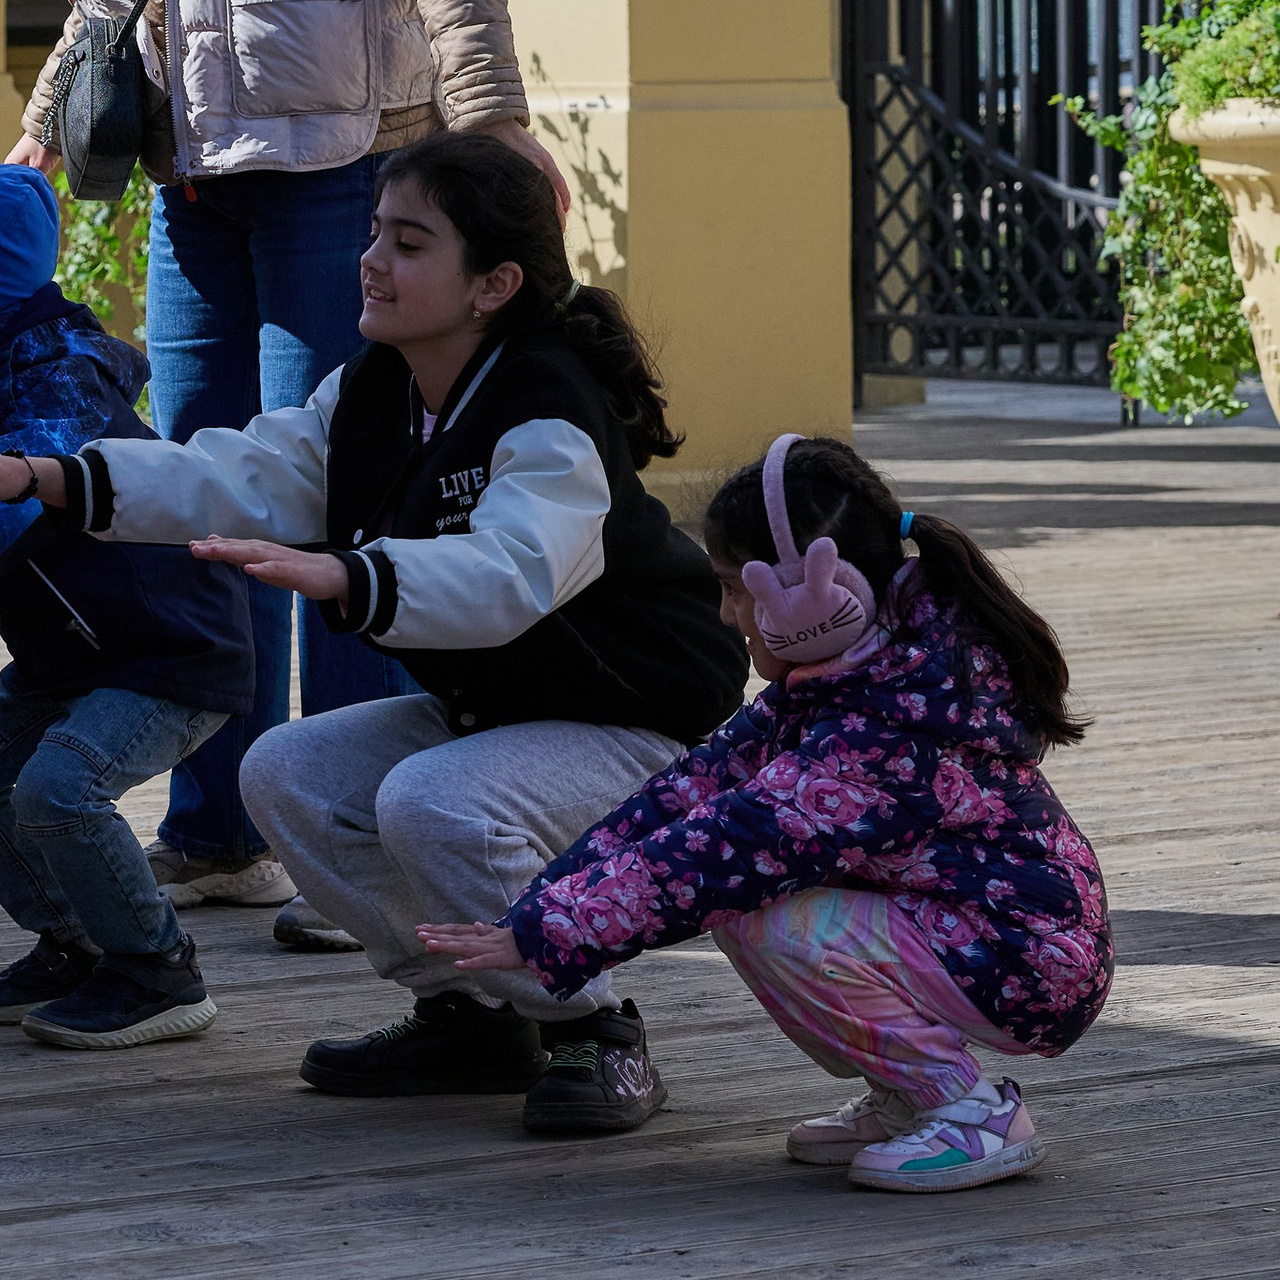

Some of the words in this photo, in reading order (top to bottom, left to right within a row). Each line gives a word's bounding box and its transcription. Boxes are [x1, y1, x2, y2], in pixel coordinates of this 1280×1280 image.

[439, 466, 486, 498] LIVE
[458, 494, 473, 507] FOR
[435, 512, 469, 532] your
[786, 622, 830, 646] LOVE
